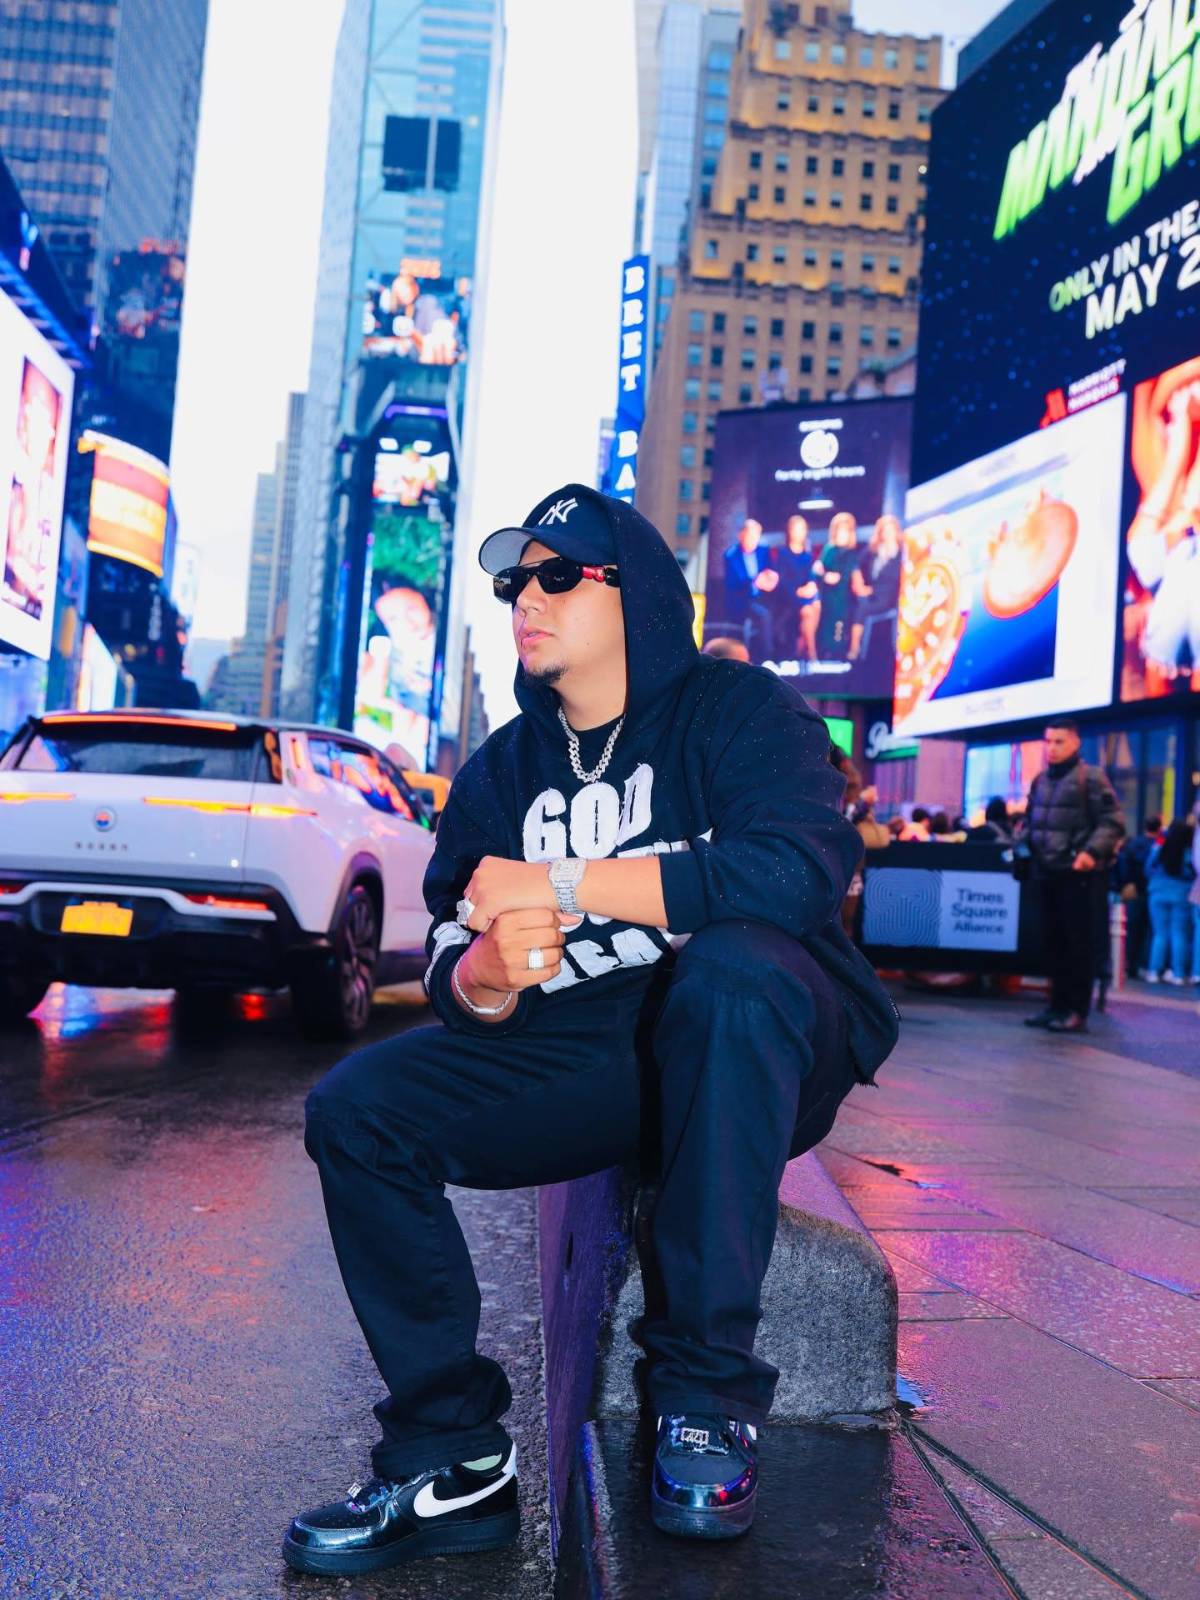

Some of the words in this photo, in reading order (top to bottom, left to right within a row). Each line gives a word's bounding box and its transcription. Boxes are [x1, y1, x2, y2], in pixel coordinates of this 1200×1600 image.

[993, 0, 1200, 241] MANDAL
[1049, 252, 1110, 312] ONLY
[1112, 235, 1141, 278] IN
[1144, 199, 1200, 257] THE
[1085, 251, 1169, 339] MAY
[621, 265, 645, 392] BRET
[615, 430, 639, 505] BA
[537, 497, 579, 526] NY
[522, 762, 654, 863] GOD
[951, 903, 1008, 920] Square
[953, 921, 1005, 935] Alliance
[956, 887, 1005, 904] Times
